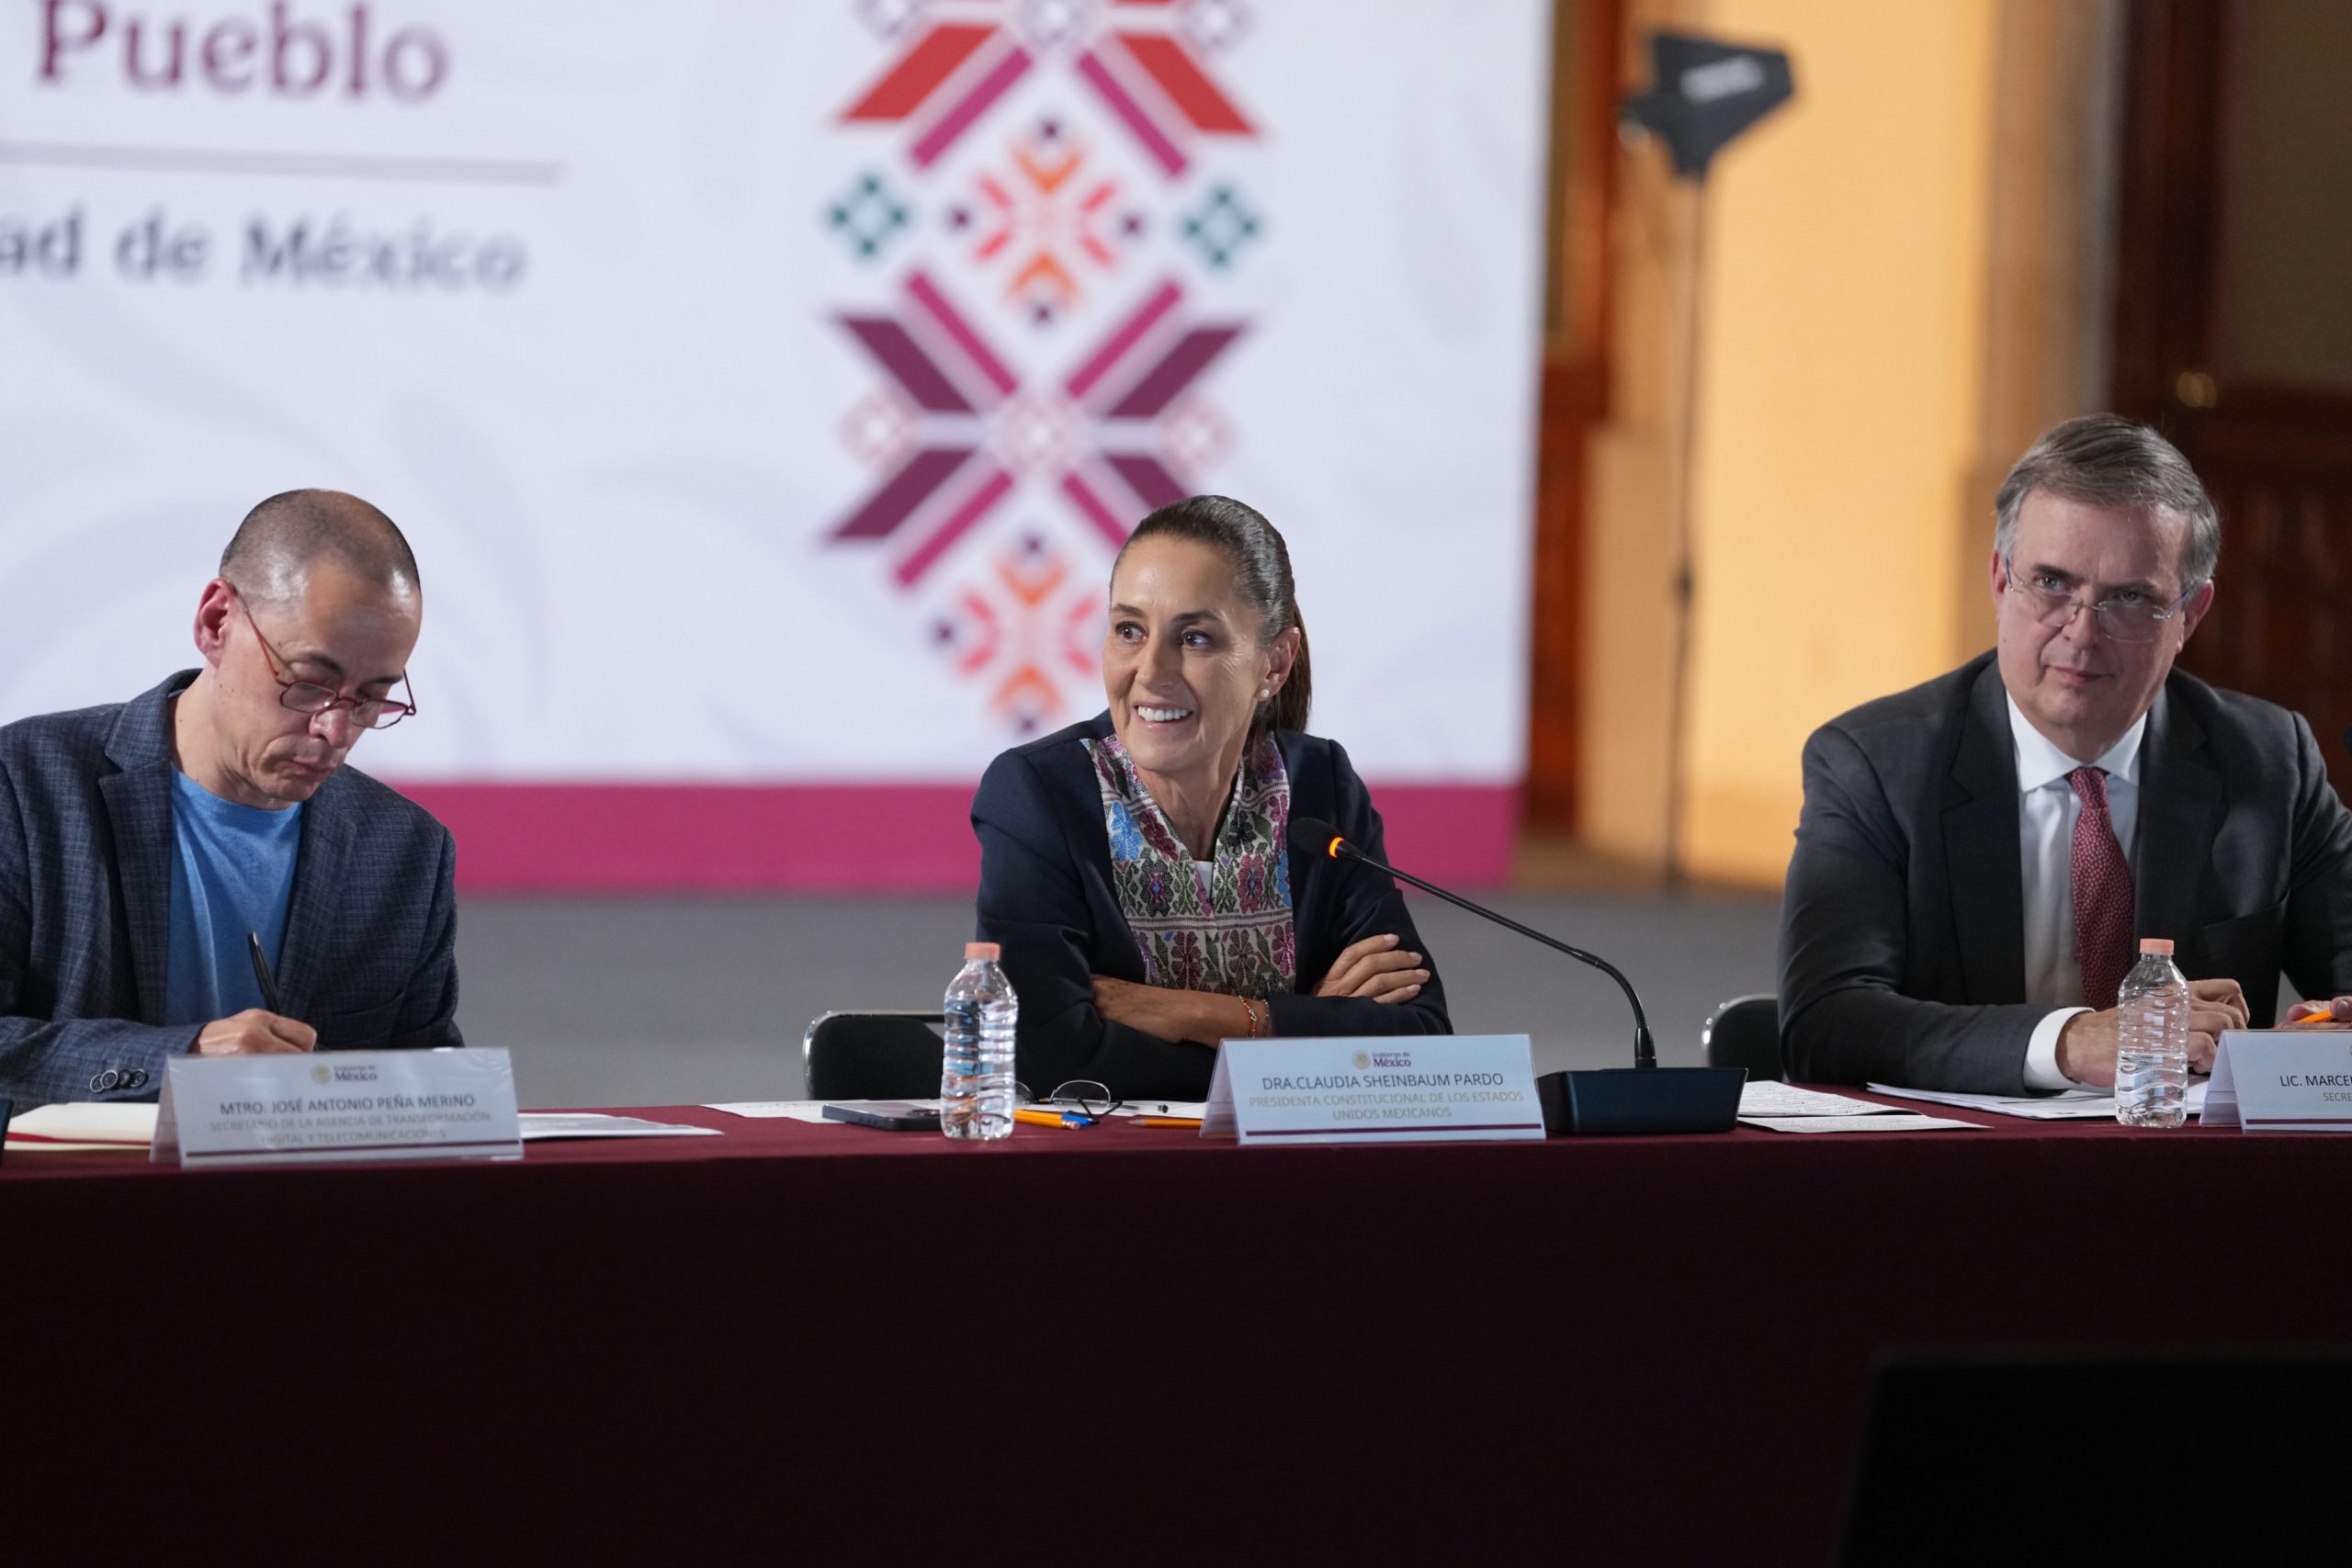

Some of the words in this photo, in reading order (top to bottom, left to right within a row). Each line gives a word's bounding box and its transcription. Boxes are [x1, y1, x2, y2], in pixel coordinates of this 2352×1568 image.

[37, 0, 449, 104] Pueblo
[113, 205, 211, 279] de
[237, 210, 529, 294] México
[1373, 1057, 1411, 1067] México
[334, 1071, 378, 1081] México
[1261, 1075, 1361, 1090] DRA.CLAUDIA
[1363, 1074, 1450, 1088] SHEINBAUM
[1453, 1073, 1504, 1087] PARDO
[2279, 1075, 2302, 1087] LIC.
[271, 1097, 302, 1112] JOSÉ
[308, 1097, 373, 1111] ANTONIO
[377, 1093, 413, 1109] PEÑA
[417, 1094, 475, 1108] MERINO
[1249, 1095, 1321, 1108] PRESIDENTA
[1323, 1093, 1429, 1106] CONSTITUCIONAL
[1430, 1092, 1447, 1103] DE
[1448, 1091, 1470, 1103] LOS
[1473, 1091, 1523, 1102] ESTADOS
[281, 1119, 296, 1129] DE
[299, 1118, 312, 1129] LA
[316, 1116, 366, 1128] AGENCIA
[368, 1114, 382, 1125] DE
[1332, 1109, 1379, 1121] UNIDOS
[1382, 1107, 1452, 1120] MEXICANOS
[307, 1133, 314, 1143] Y
